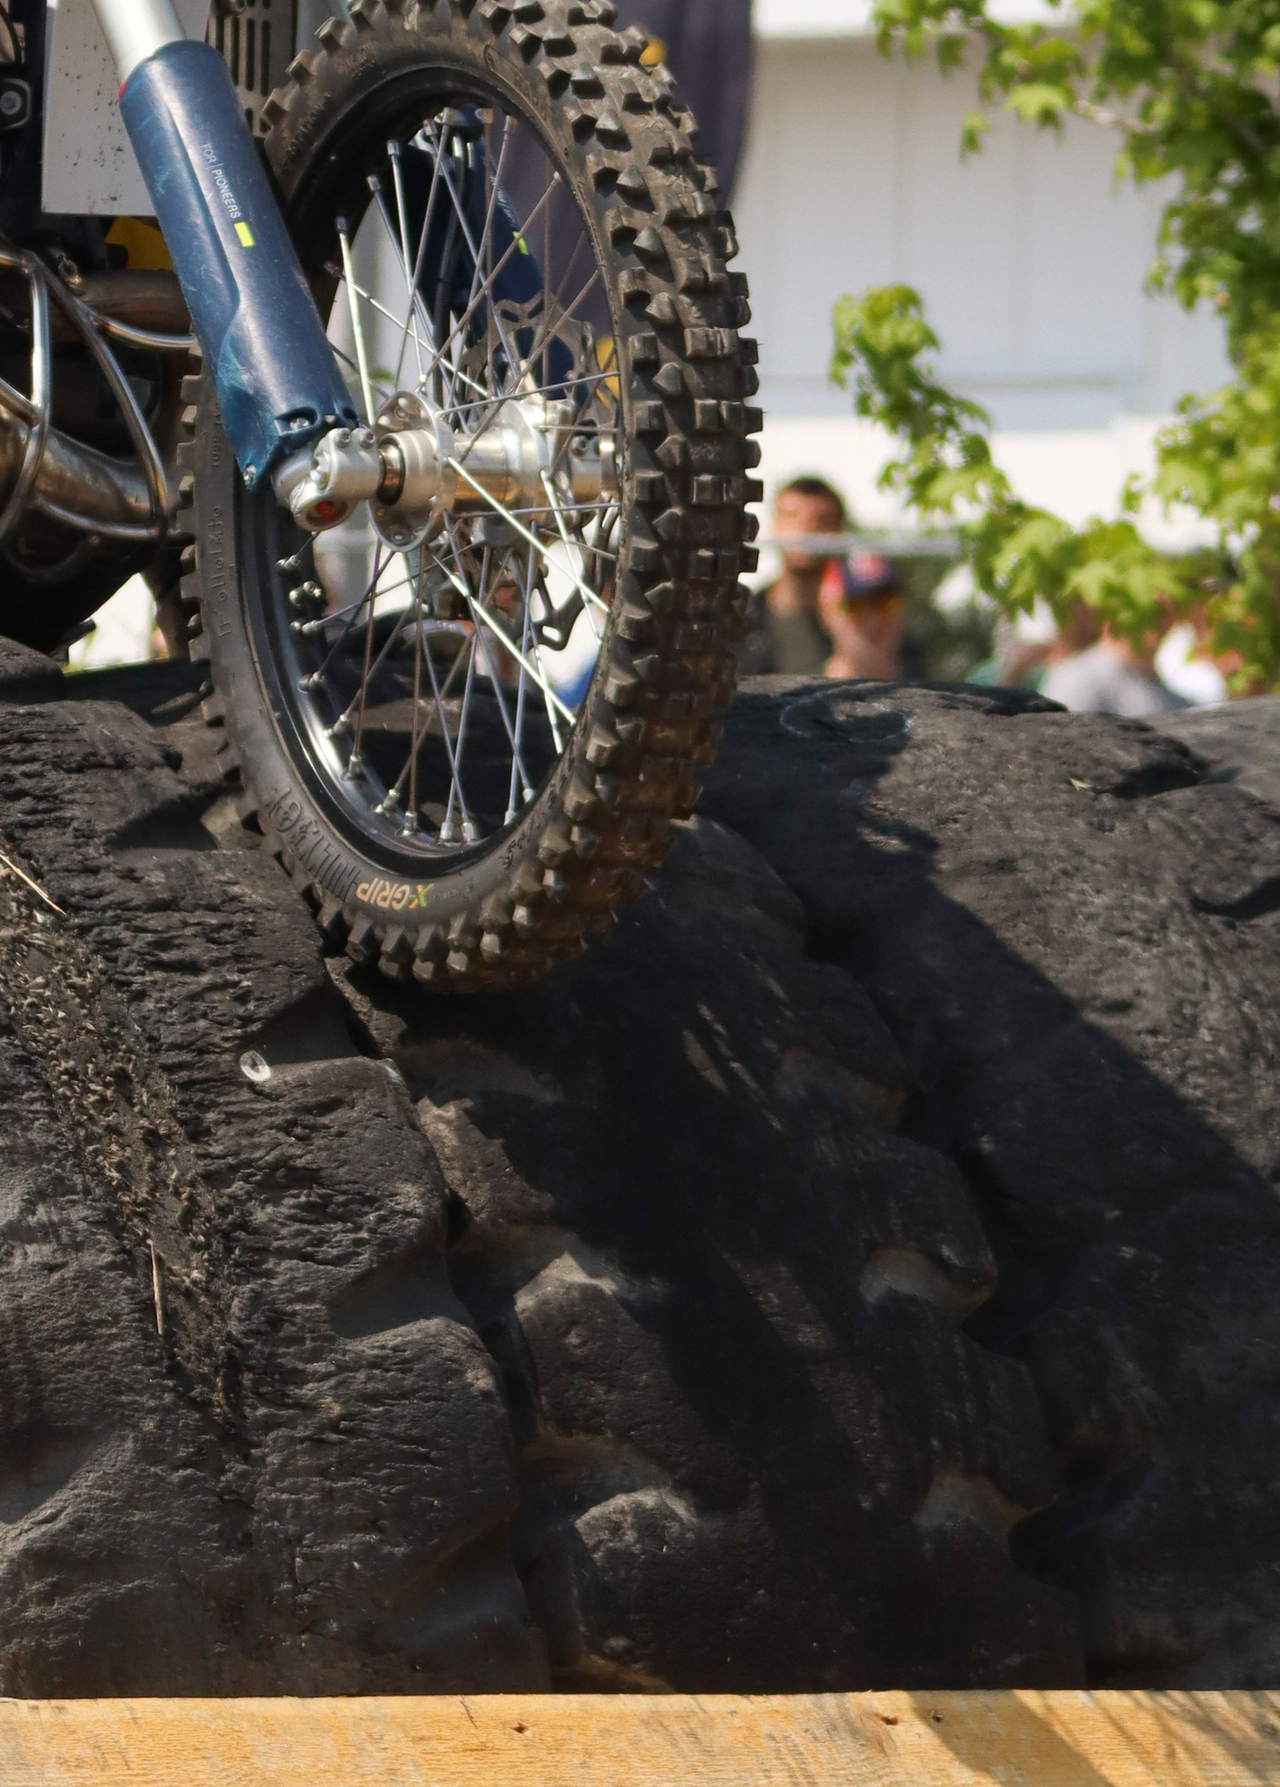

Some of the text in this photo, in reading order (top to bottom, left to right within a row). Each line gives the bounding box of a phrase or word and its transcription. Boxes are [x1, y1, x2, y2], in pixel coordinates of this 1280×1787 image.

[199, 142, 241, 219] FOR PIONEERS
[355, 875, 437, 911] X-GRIP
